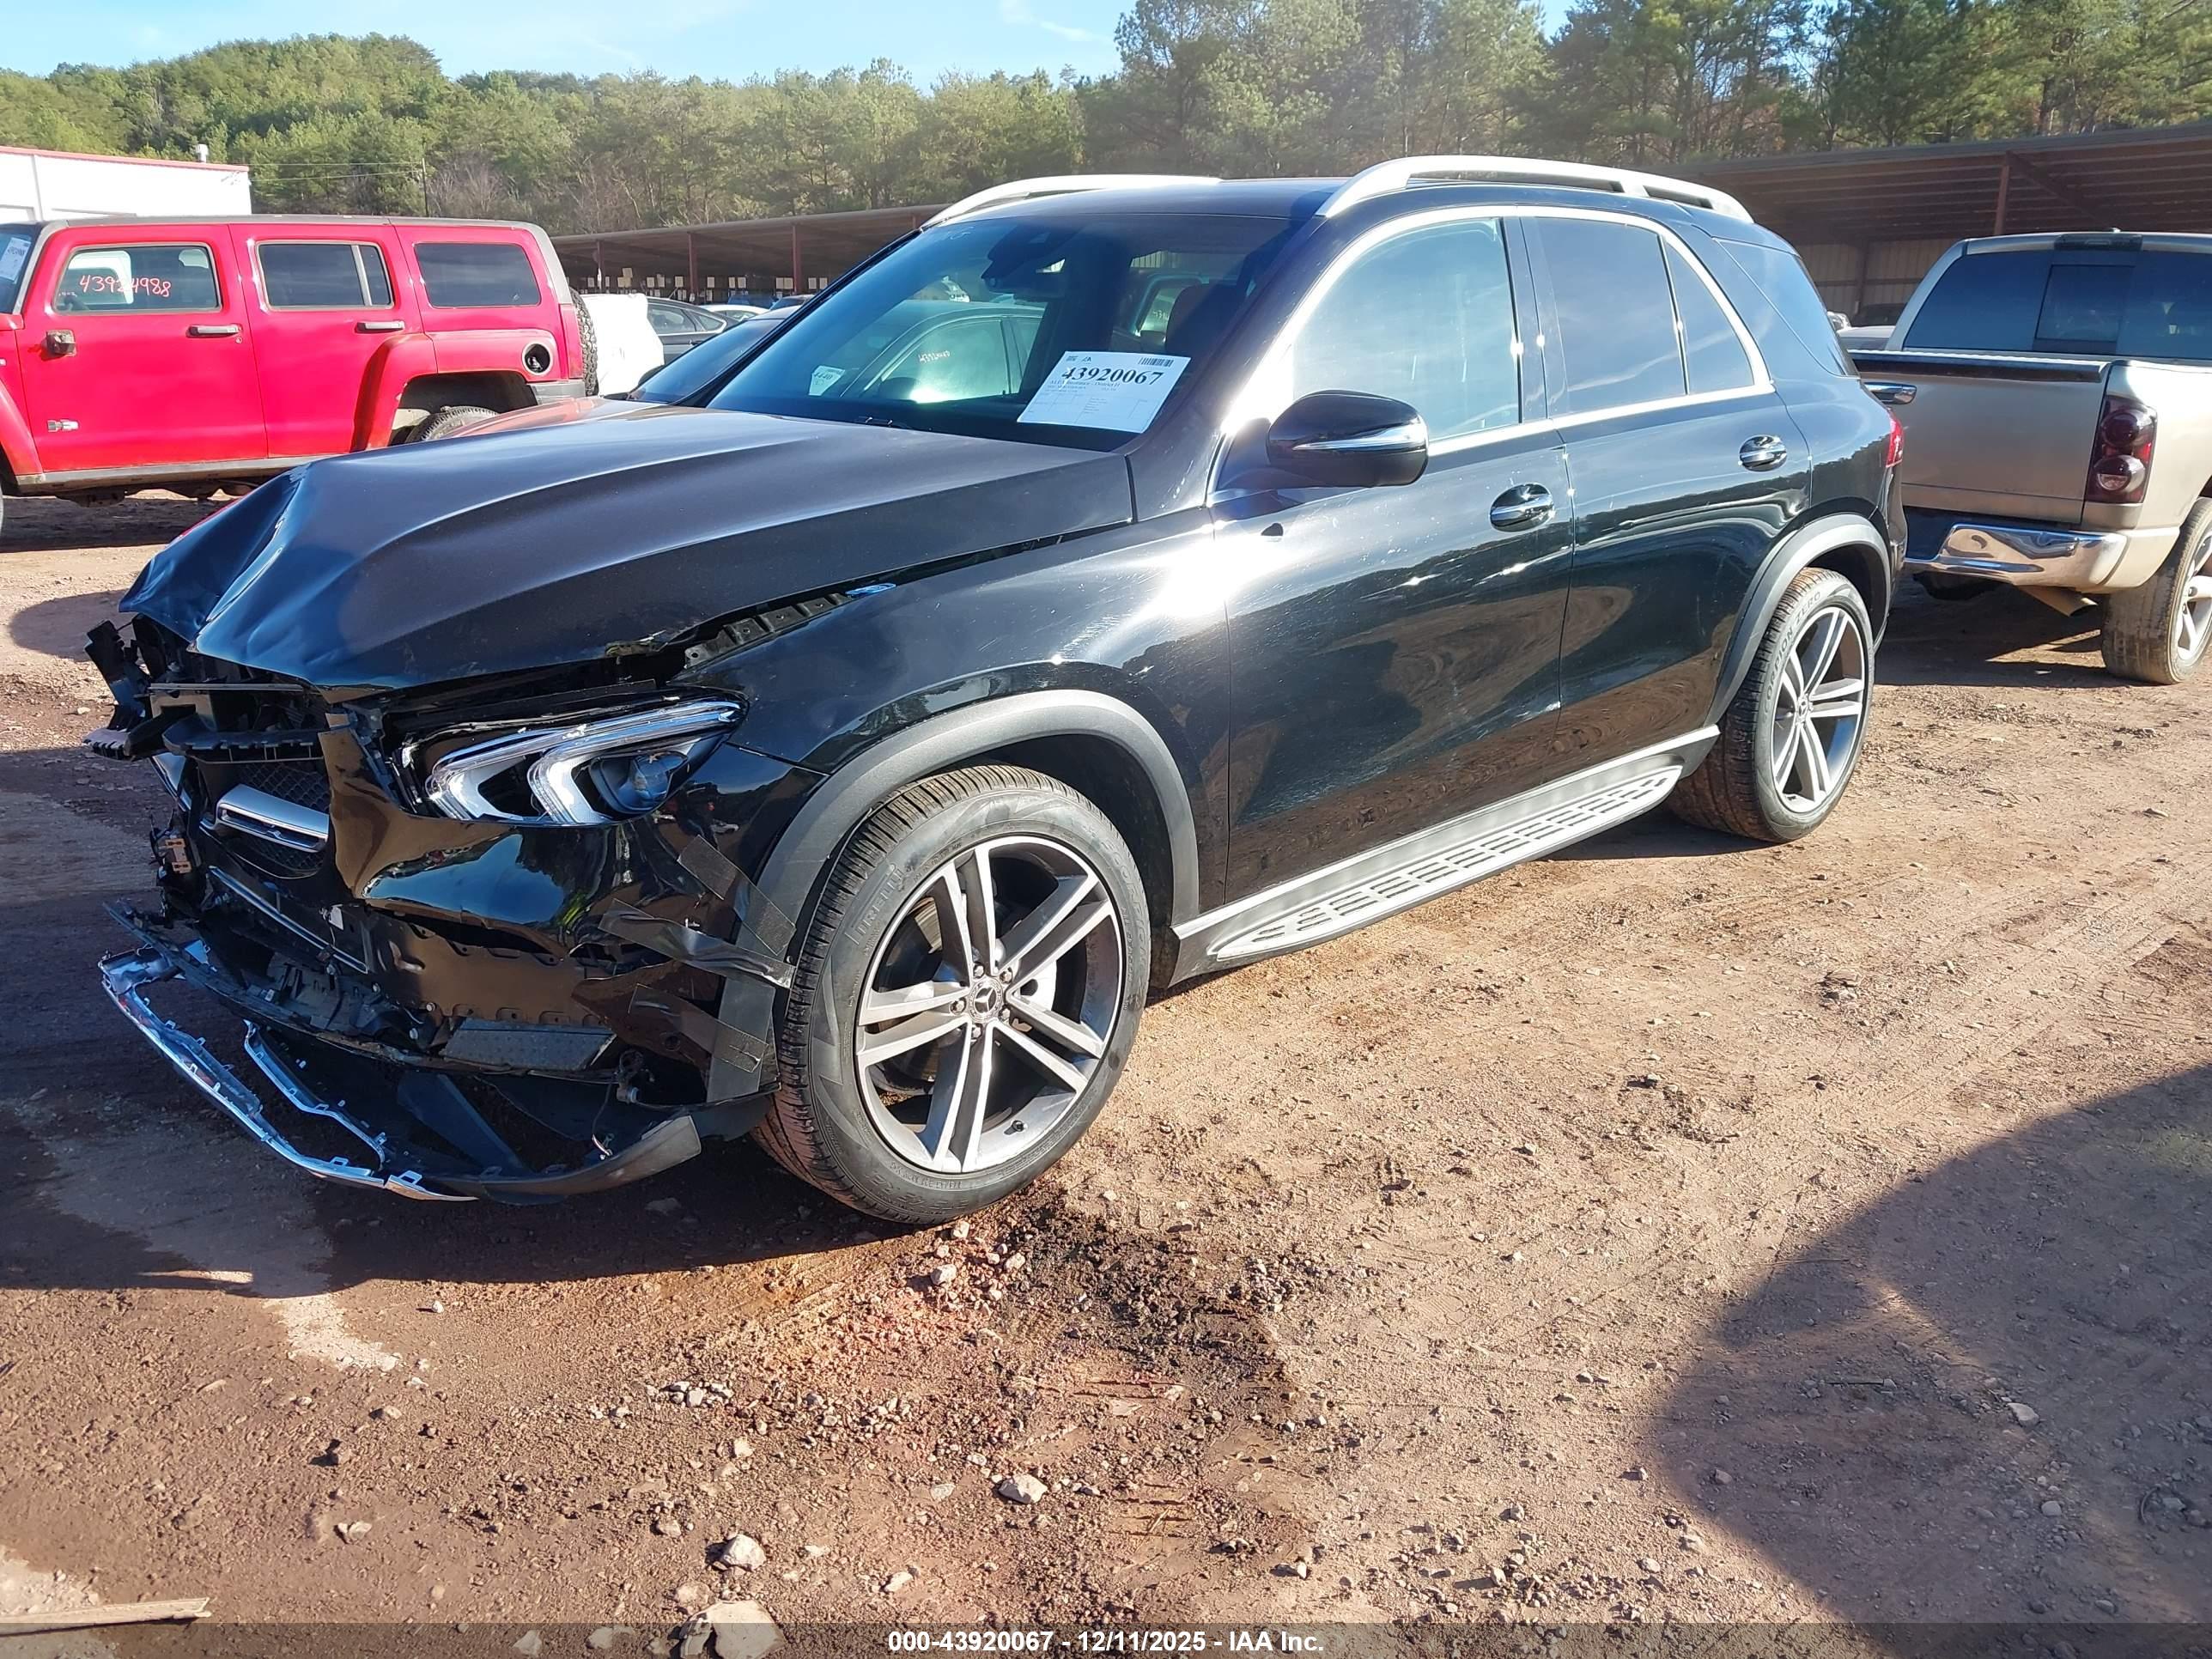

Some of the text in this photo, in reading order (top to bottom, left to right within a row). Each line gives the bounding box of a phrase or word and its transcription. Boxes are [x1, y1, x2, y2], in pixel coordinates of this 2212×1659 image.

[79, 275, 172, 297] 43924988
[1061, 367, 1164, 386] 43920067
[1795, 591, 1821, 624] ZERO
[844, 861, 904, 945] PIRELLI
